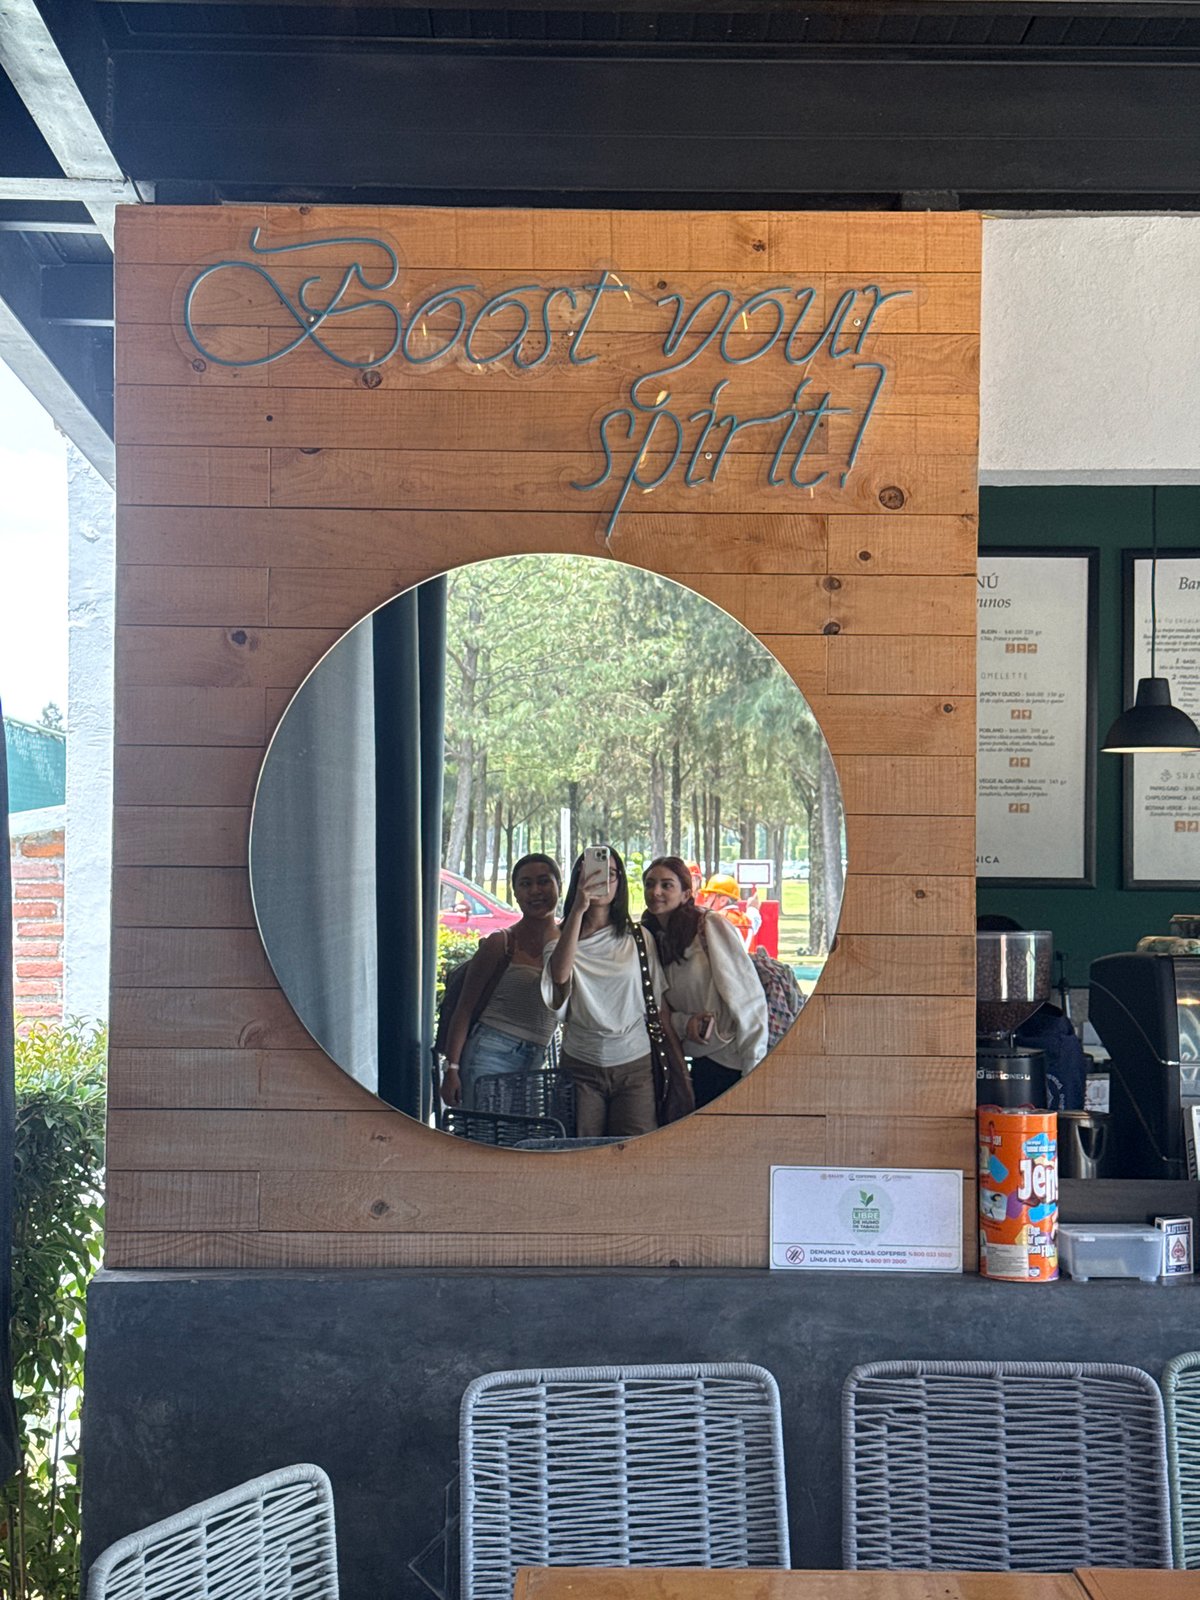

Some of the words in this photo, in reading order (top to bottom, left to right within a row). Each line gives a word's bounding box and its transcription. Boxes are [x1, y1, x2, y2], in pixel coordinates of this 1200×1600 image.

[184, 227, 632, 368] Boost
[631, 286, 914, 410] your
[570, 364, 886, 540] spirit!
[976, 597, 1011, 608] unos
[980, 672, 1028, 680] OMELETTE
